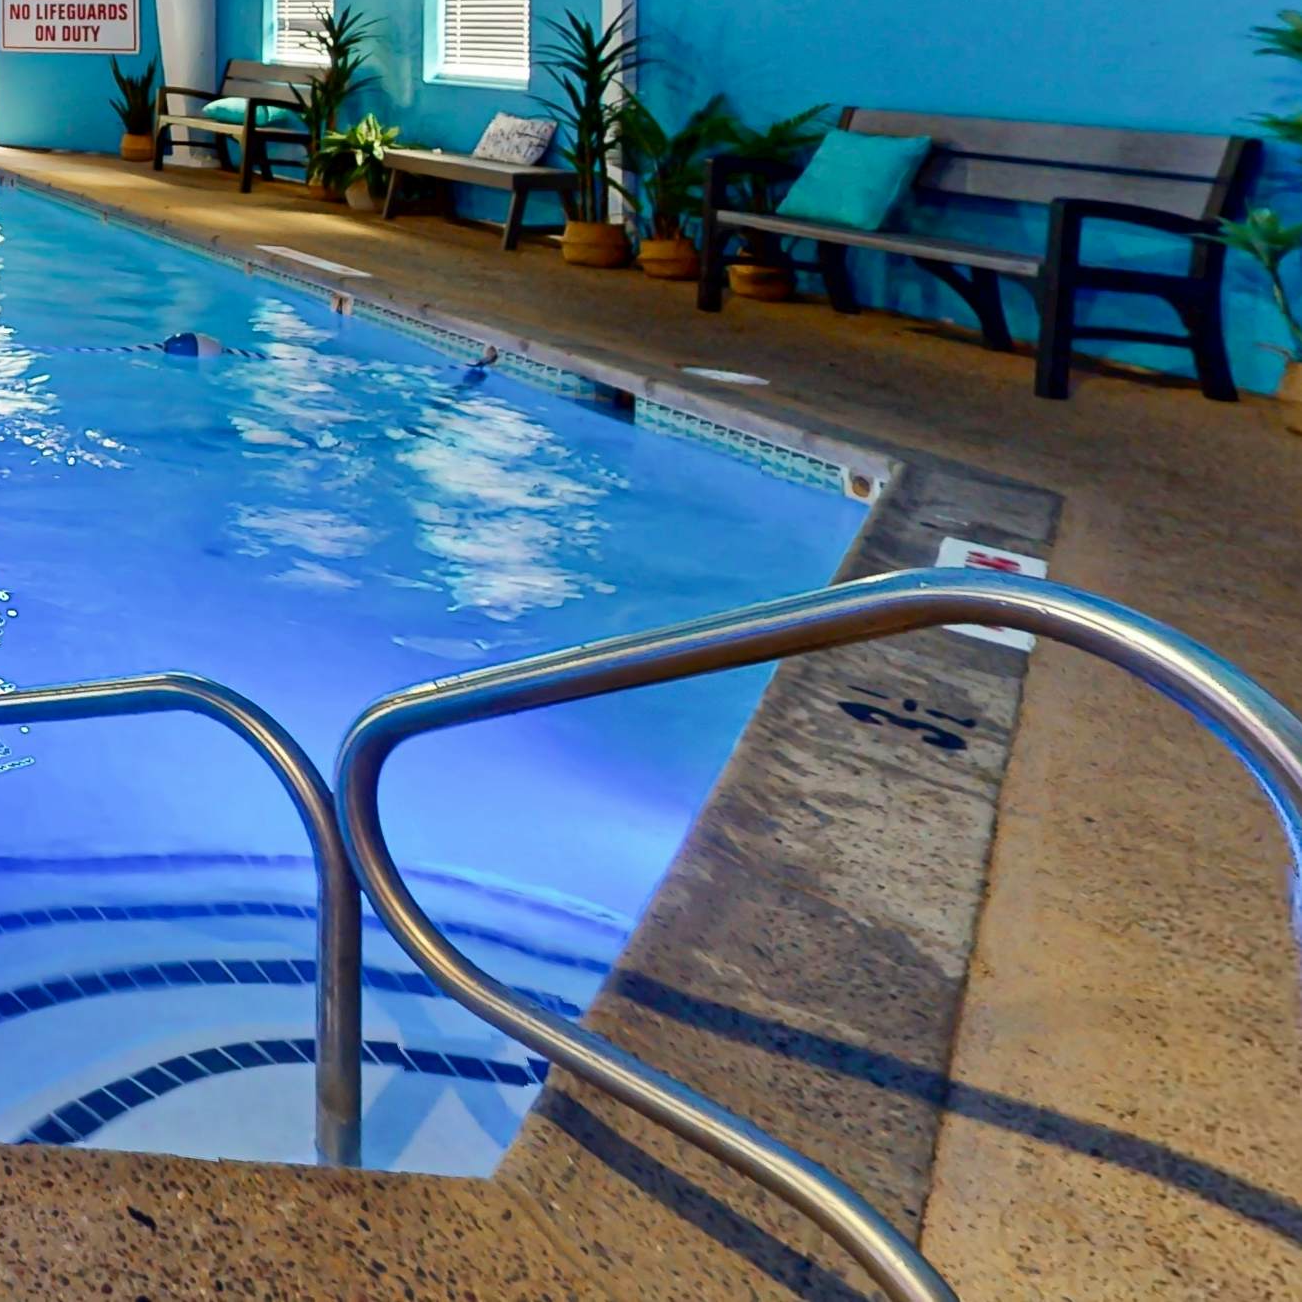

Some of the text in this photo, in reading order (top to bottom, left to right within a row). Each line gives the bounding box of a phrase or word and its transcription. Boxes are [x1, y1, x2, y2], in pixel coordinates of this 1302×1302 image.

[9, 3, 128, 20] NO LIFEGUARDS
[35, 25, 100, 42] ON DUTY
